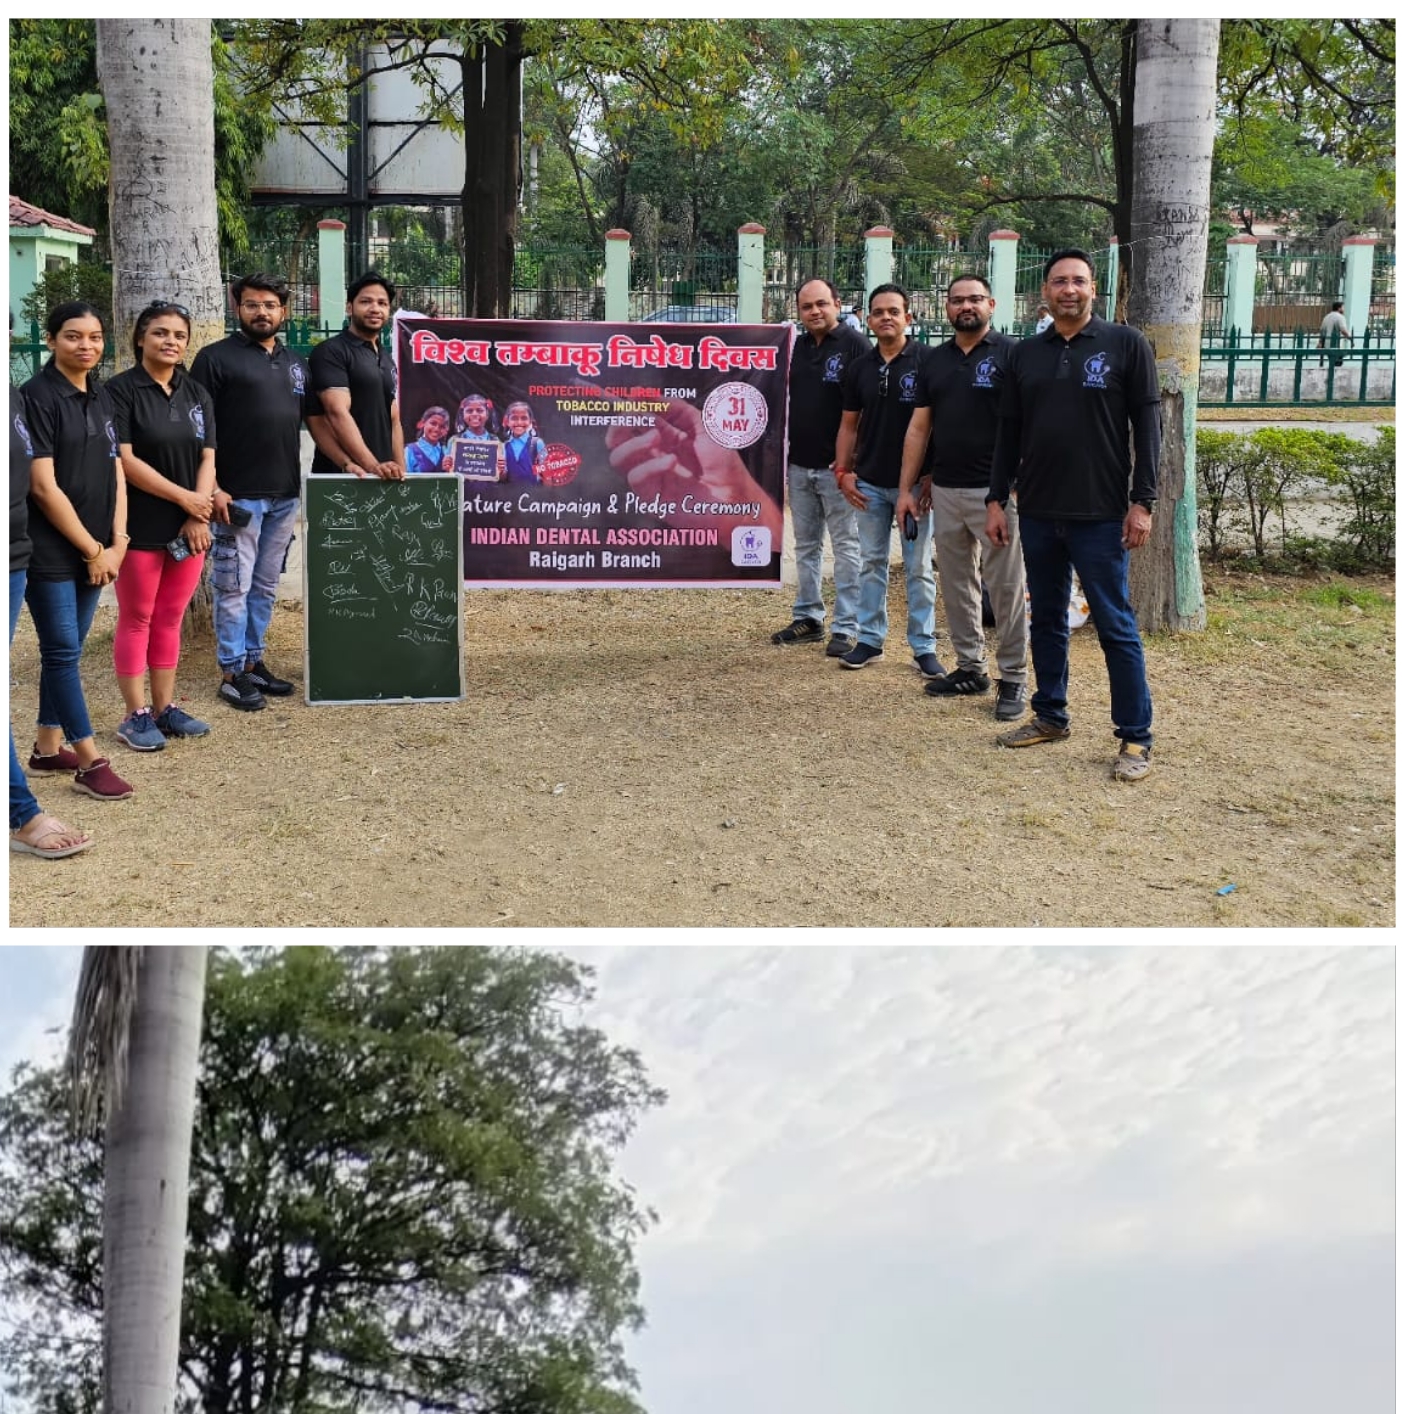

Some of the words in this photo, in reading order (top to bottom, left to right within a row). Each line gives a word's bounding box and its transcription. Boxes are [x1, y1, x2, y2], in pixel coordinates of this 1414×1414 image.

[410, 329, 489, 365] विश्व
[496, 341, 602, 377] तम्बाकू
[608, 334, 694, 370] निषेध
[698, 336, 778, 372] दिवस
[529, 385, 601, 397] PROTECTING
[604, 386, 661, 398] CHILDREN
[664, 387, 696, 399] FROM
[556, 400, 610, 412] TOBACCO
[613, 400, 670, 412] INDUSTRY
[727, 397, 746, 416] 31
[570, 415, 656, 427] INTERFERENCE
[722, 419, 750, 432] MAY
[462, 497, 512, 514] ature
[518, 493, 601, 519] Campaign
[607, 494, 618, 515] &
[625, 492, 676, 519] Pledge
[682, 494, 761, 518] Ceremony
[470, 527, 530, 545] INDIAN
[536, 528, 601, 545] DENTAL
[606, 528, 718, 546] ASSOCIATION
[529, 551, 596, 571] Raigarh
[601, 551, 661, 568] Branch
